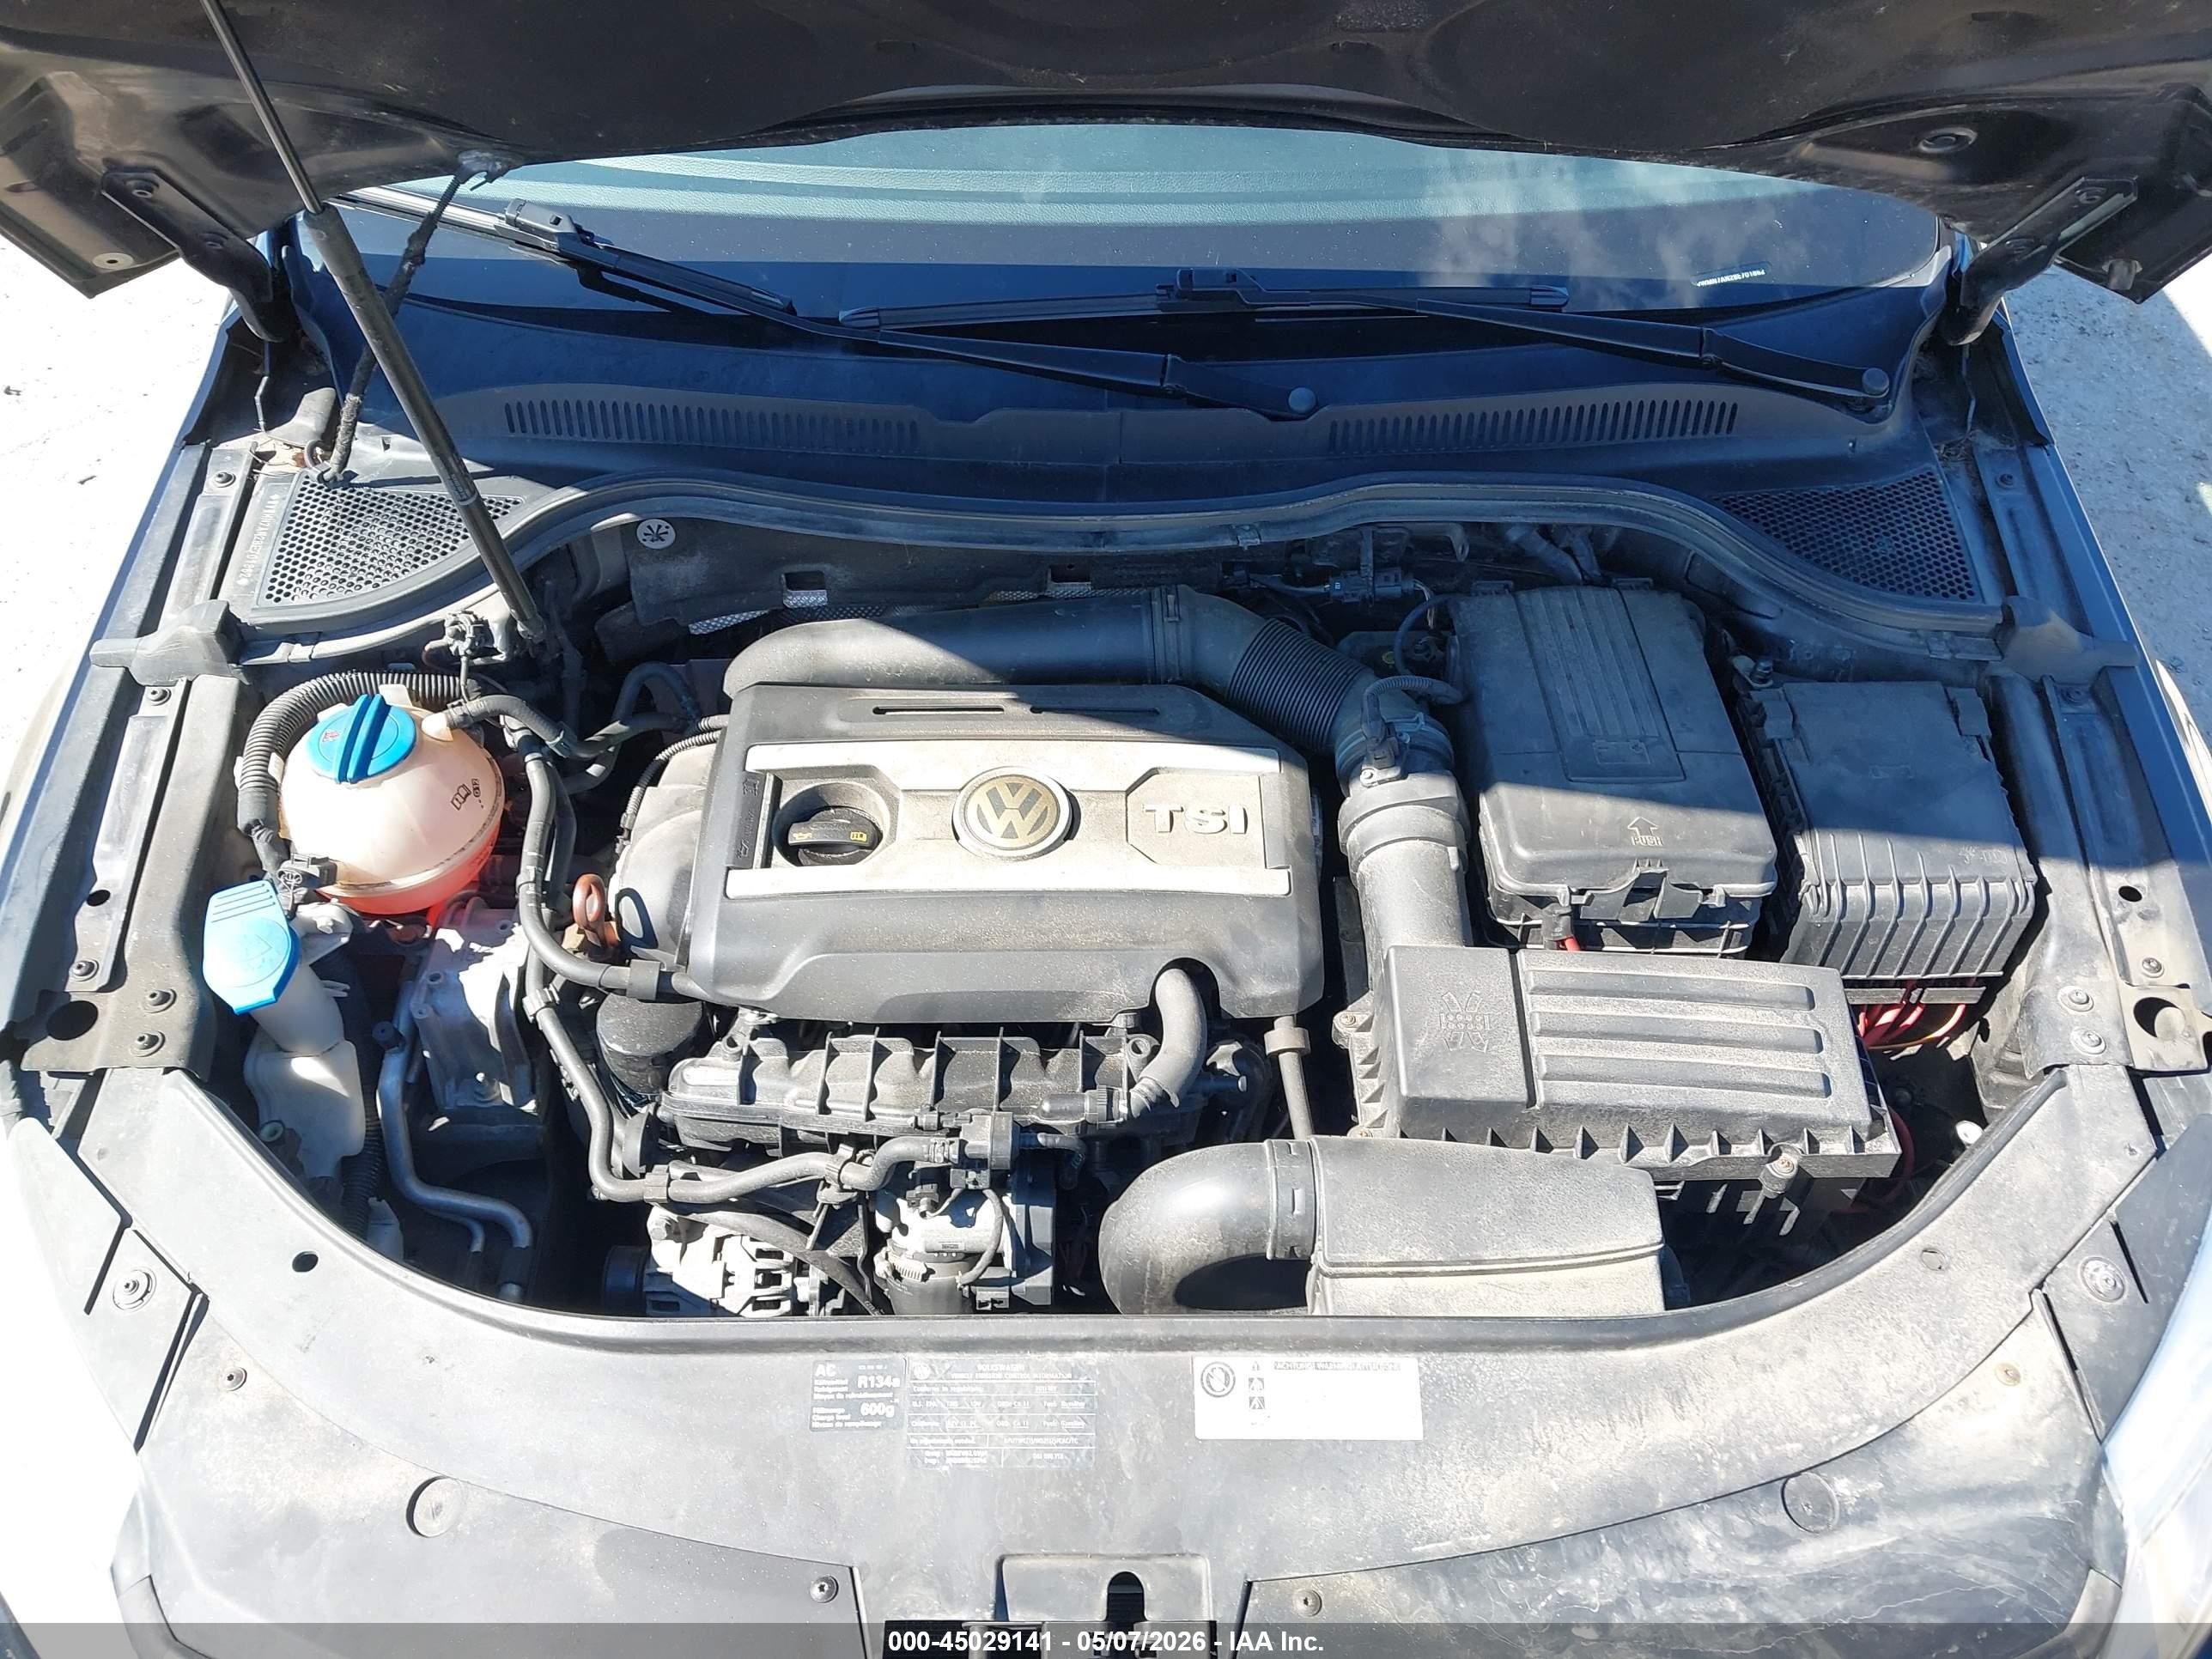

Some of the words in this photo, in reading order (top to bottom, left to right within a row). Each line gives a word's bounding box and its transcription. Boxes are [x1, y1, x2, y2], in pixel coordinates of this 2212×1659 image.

[1144, 804, 1249, 836] TSI
[1631, 836, 1663, 847] PUSH
[815, 1363, 837, 1377] AC
[857, 1375, 901, 1389] R134a
[860, 1402, 895, 1418] 600g
